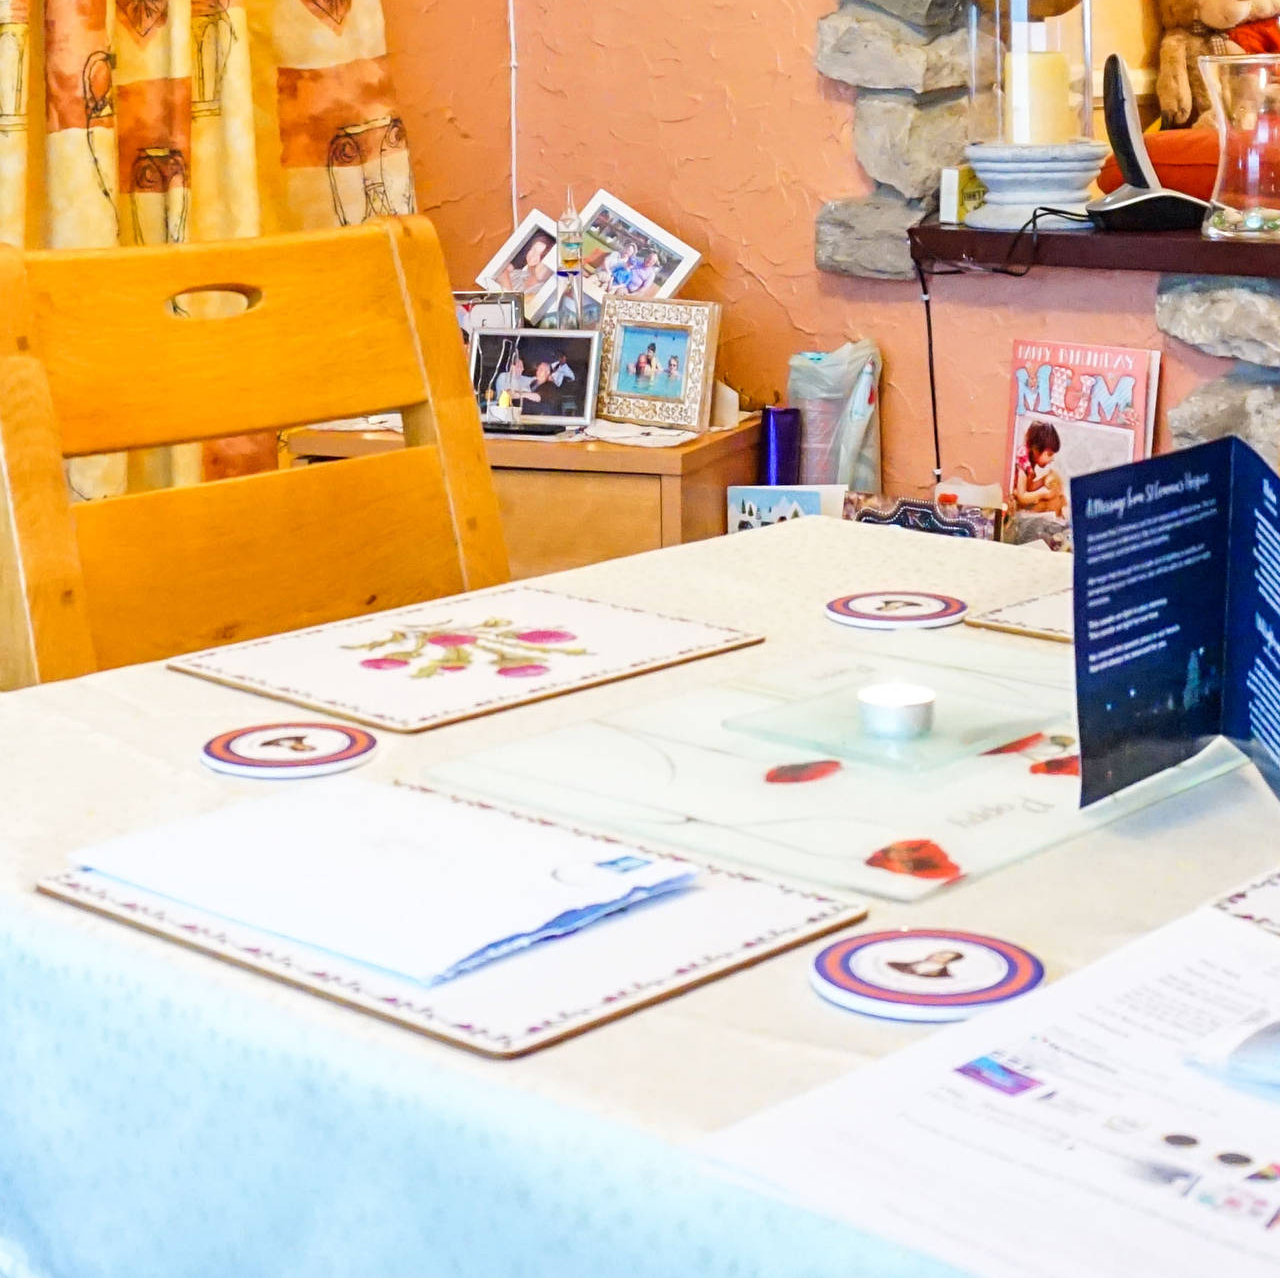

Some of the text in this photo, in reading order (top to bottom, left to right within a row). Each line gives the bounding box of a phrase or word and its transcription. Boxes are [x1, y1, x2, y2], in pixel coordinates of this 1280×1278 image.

[1017, 345, 1135, 370] HAPPY BIRTHDAY
[1015, 364, 1136, 423] MUM
